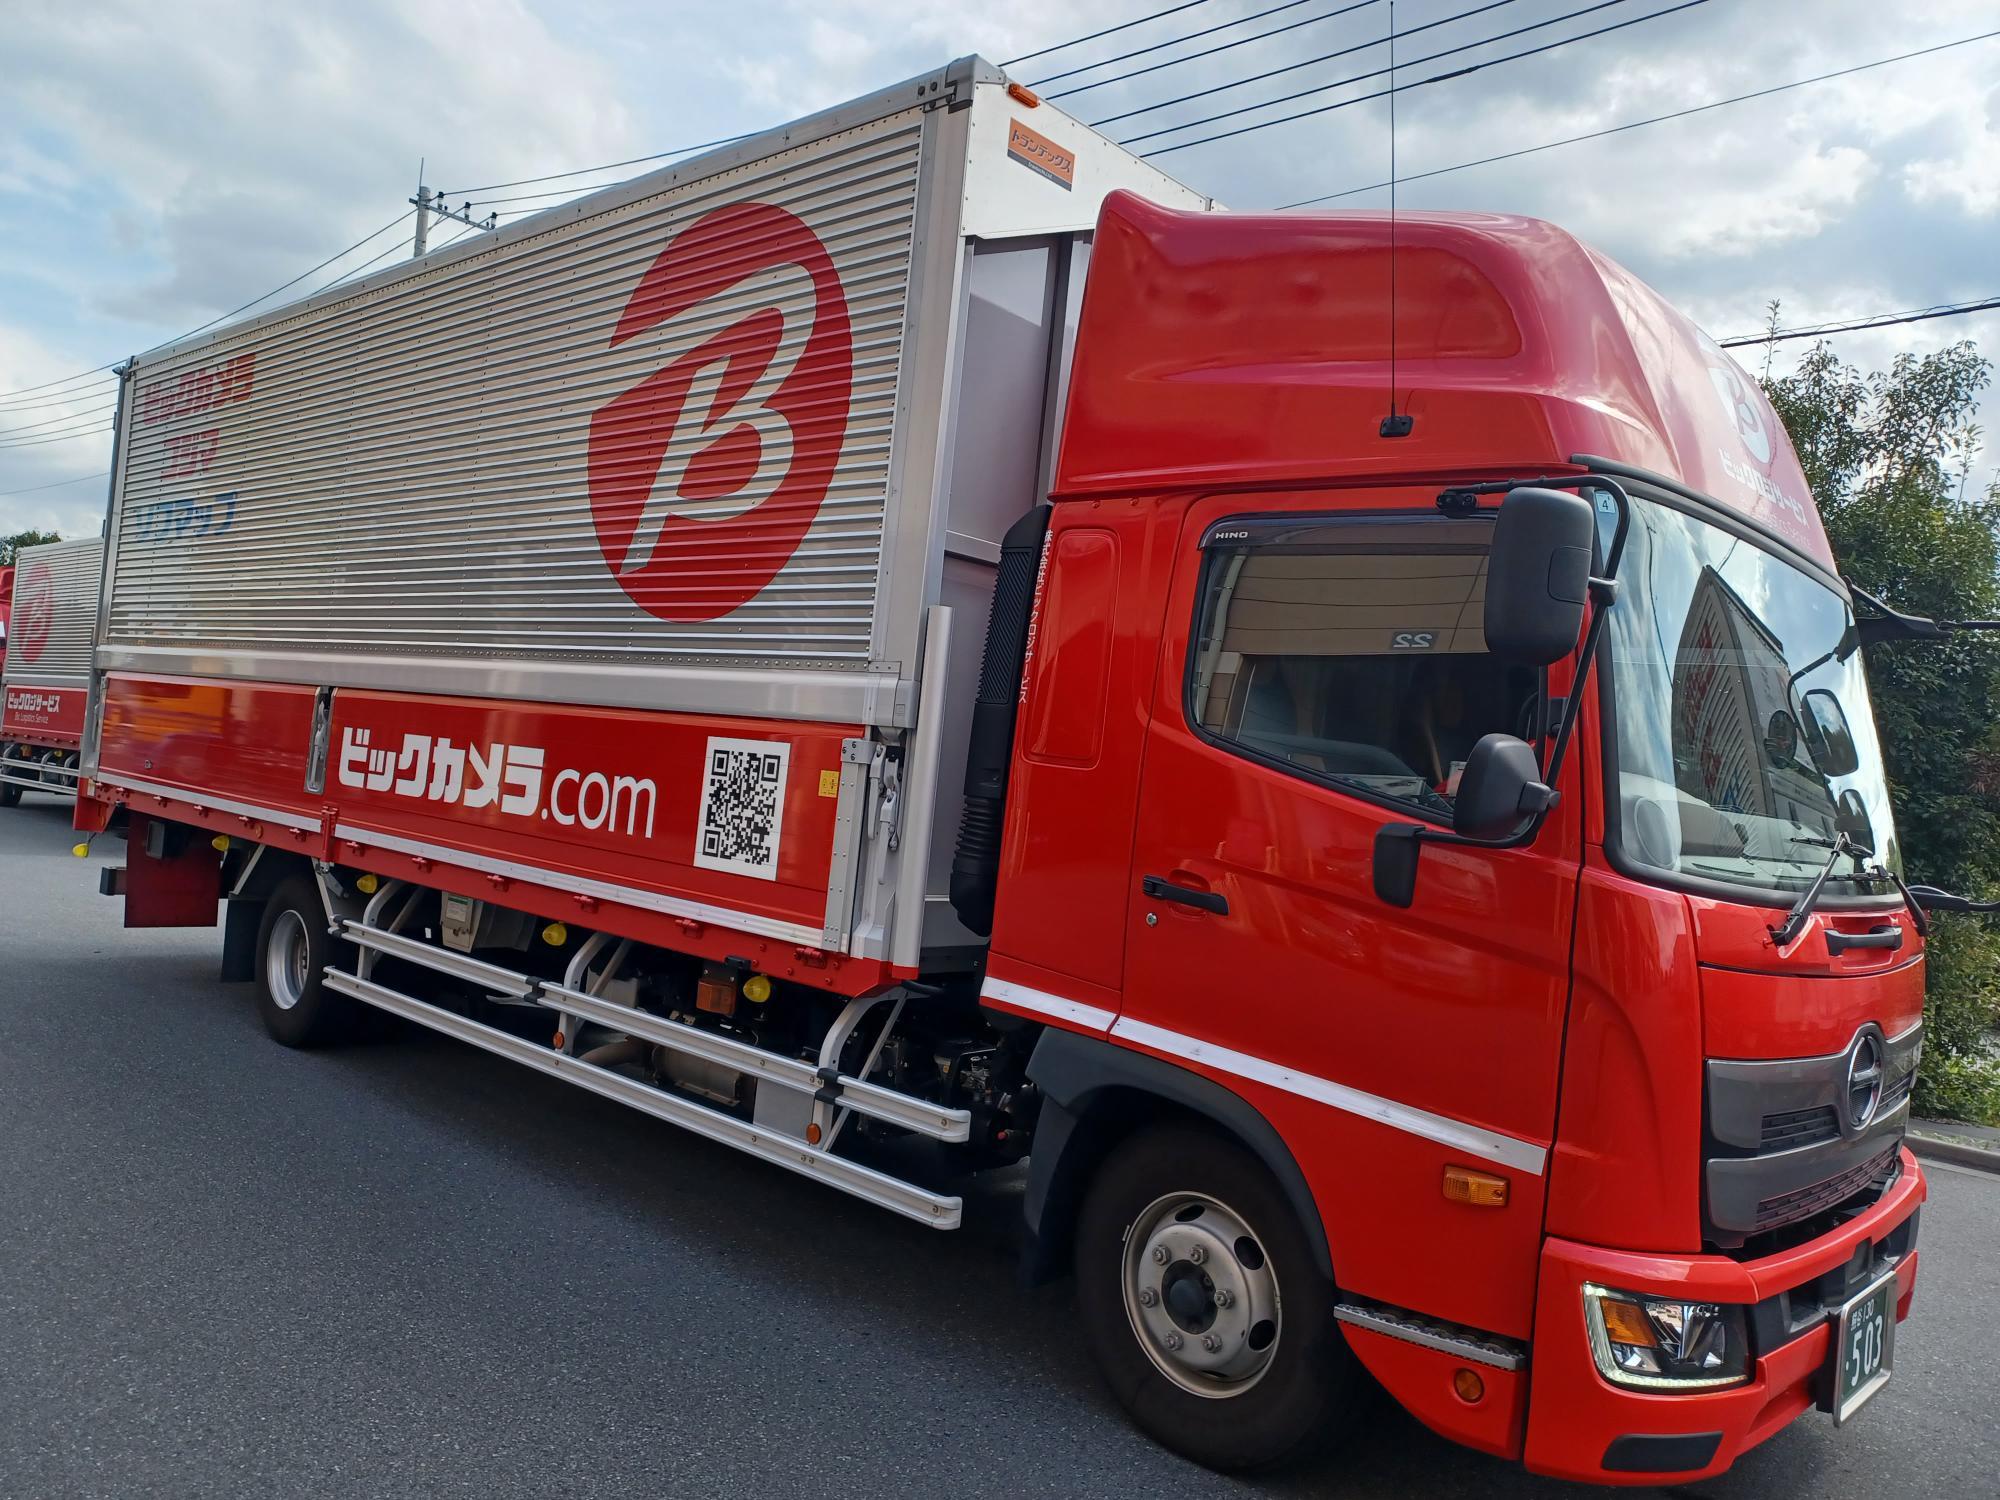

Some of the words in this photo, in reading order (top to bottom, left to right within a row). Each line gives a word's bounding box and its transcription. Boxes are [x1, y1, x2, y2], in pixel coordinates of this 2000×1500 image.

[1011, 129, 1072, 174] トランテックス
[1215, 530, 1249, 540] HINO
